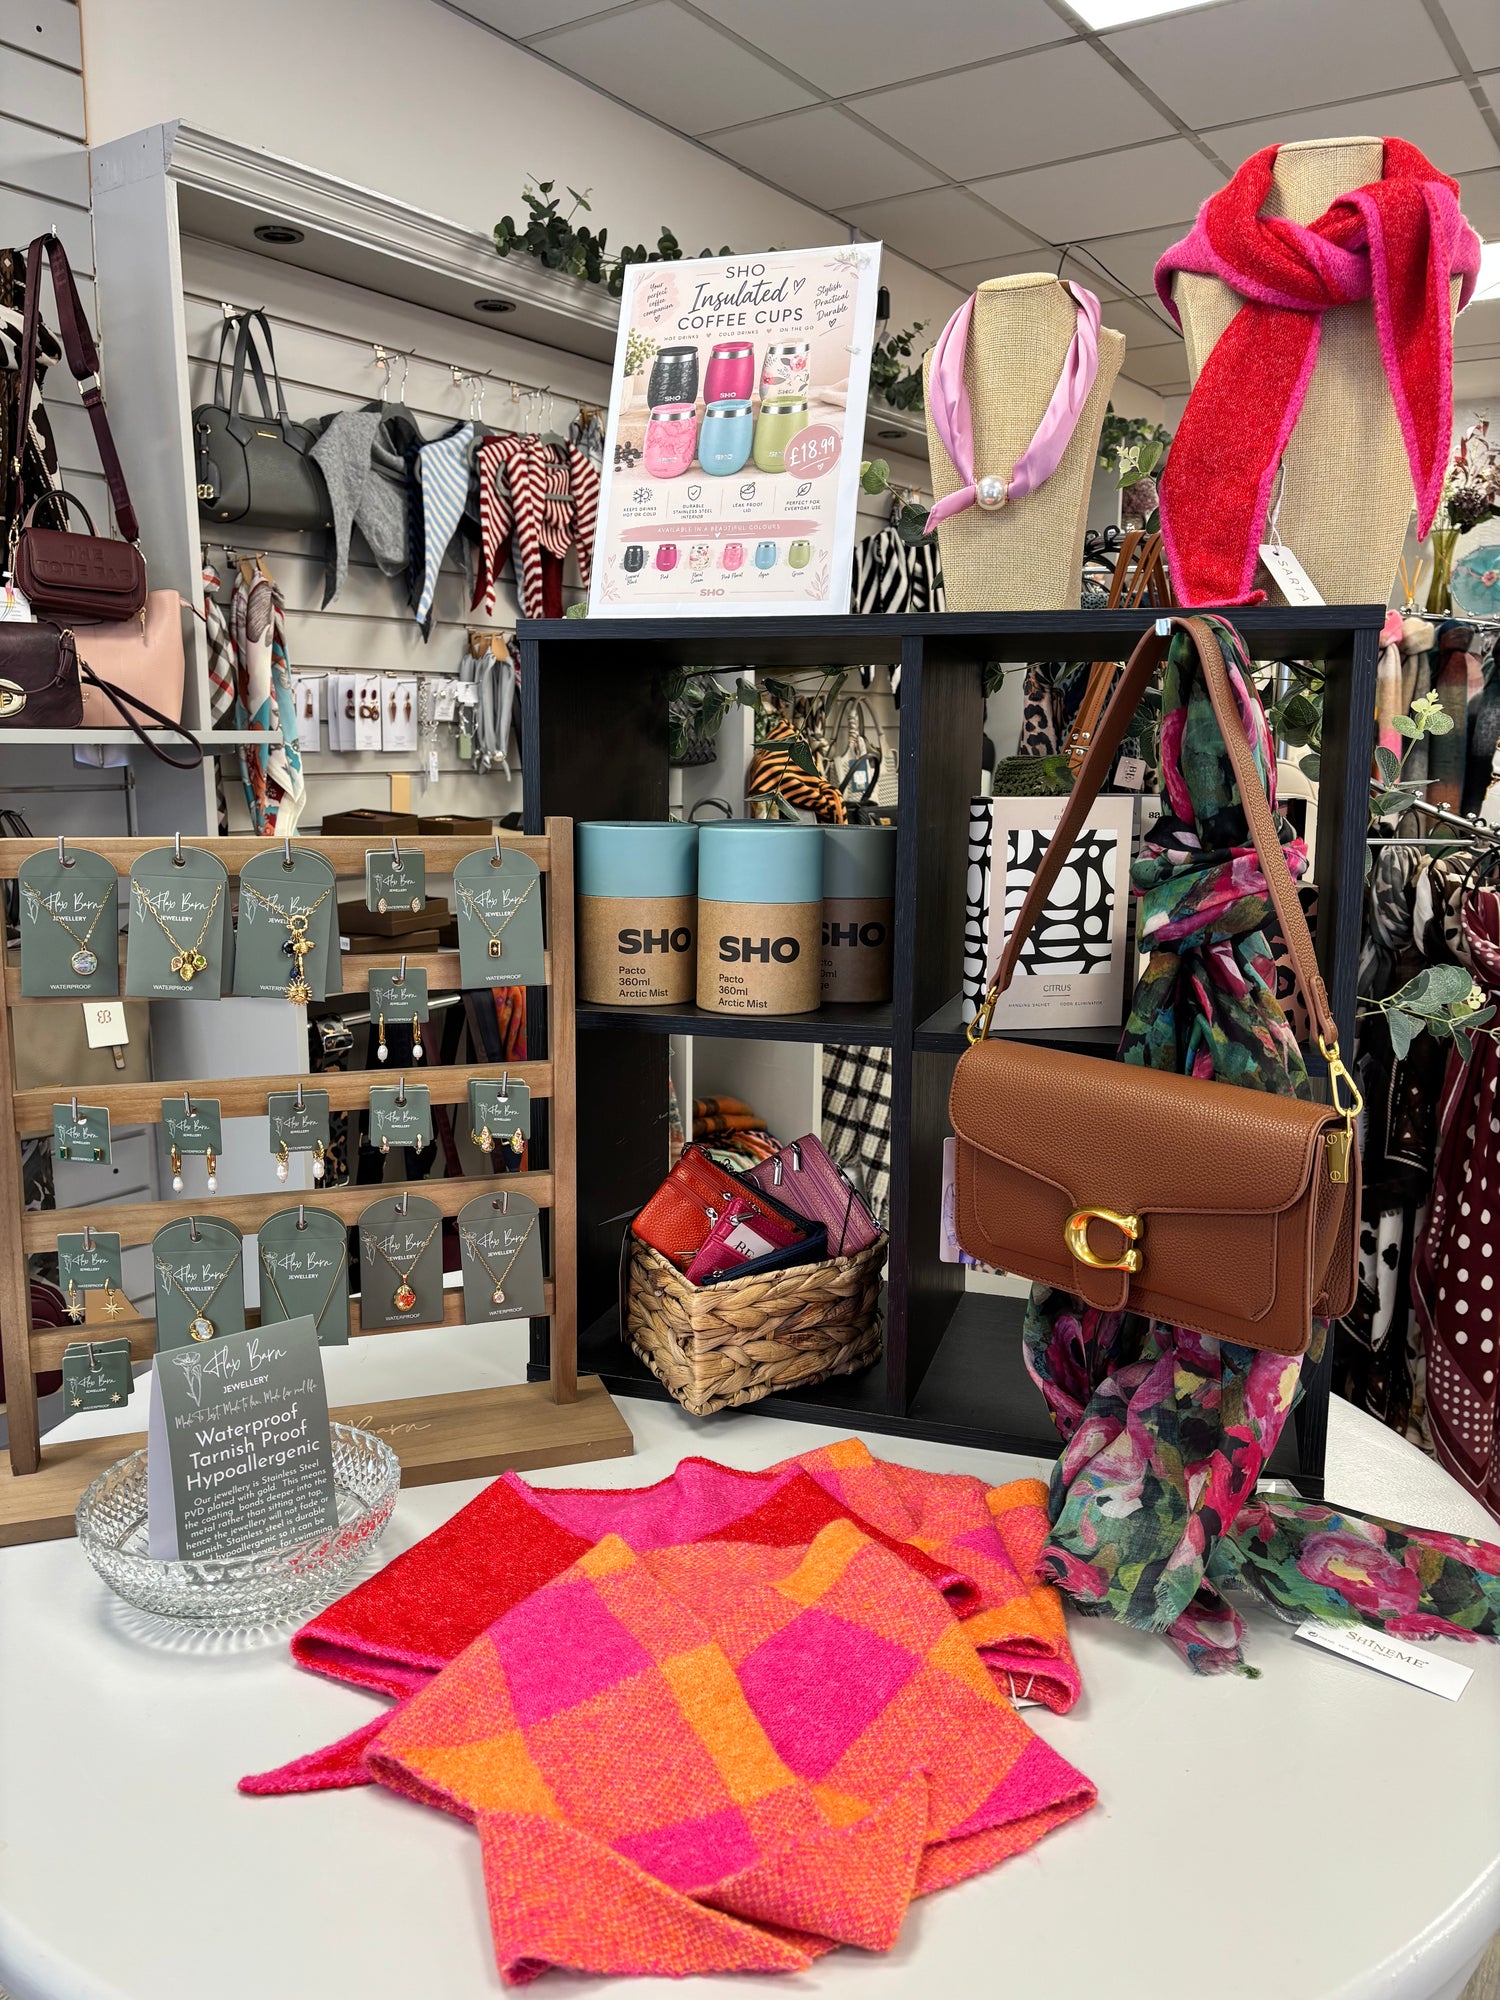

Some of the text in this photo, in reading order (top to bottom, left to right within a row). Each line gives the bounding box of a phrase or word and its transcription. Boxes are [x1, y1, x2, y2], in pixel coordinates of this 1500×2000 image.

[725, 264, 766, 279] SHO
[688, 277, 789, 314] Insulated
[817, 281, 842, 297] Stylish
[814, 290, 849, 309] Practical
[678, 307, 803, 330] COFFEE CUPS
[817, 303, 849, 321] Durable
[790, 436, 836, 466] £18.99
[1277, 560, 1310, 602] SARTA
[700, 588, 725, 597] SHO
[73, 892, 103, 912] Barn
[180, 893, 210, 913] Barn
[618, 926, 692, 954] SHO
[718, 935, 801, 964] SHO
[619, 965, 646, 975] Pacto
[719, 974, 744, 984] Pacto
[152, 984, 194, 992] WATERPROOF
[619, 977, 650, 987] 360ml
[718, 986, 748, 996] 360ml
[1042, 984, 1072, 992] CITRUS
[619, 988, 669, 999] Arctic Mist
[718, 998, 768, 1009] Arctic Mist
[307, 1251, 333, 1270] Barn
[385, 1313, 420, 1321] WATERPROOF
[488, 1307, 524, 1316] WATERPROOF
[202, 1338, 288, 1379] Flax Barn
[223, 1374, 270, 1394] JEWELLERY
[195, 1402, 298, 1447] Waterproof
[189, 1418, 307, 1469] Tarnish Proof
[186, 1440, 320, 1491] Hypoallergenic
[194, 1497, 211, 1507] Our
[213, 1483, 251, 1500] jewellery
[261, 1469, 298, 1484] Stainless
[299, 1459, 320, 1472] Steel
[184, 1469, 327, 1520] PVD plated with gold. This means
[184, 1477, 327, 1530] the coating bonds deeper into the
[190, 1489, 324, 1538] metal rather than sitting on top,
[185, 1538, 212, 1550] hence
[214, 1531, 228, 1540] the
[230, 1518, 267, 1536] jewellery
[268, 1510, 282, 1521] will
[284, 1506, 298, 1516] not
[300, 1501, 319, 1512] fade
[192, 1544, 225, 1559] tarnish.
[226, 1529, 264, 1546] Stainless
[265, 1521, 285, 1532] steel
[286, 1517, 293, 1525] is
[295, 1507, 326, 1522] durable
[215, 1535, 277, 1560] hypoallergenic
[278, 1530, 288, 1538] so
[290, 1526, 297, 1534] it
[298, 1522, 313, 1531] can
[314, 1517, 325, 1526] be
[280, 1539, 293, 1547] for
